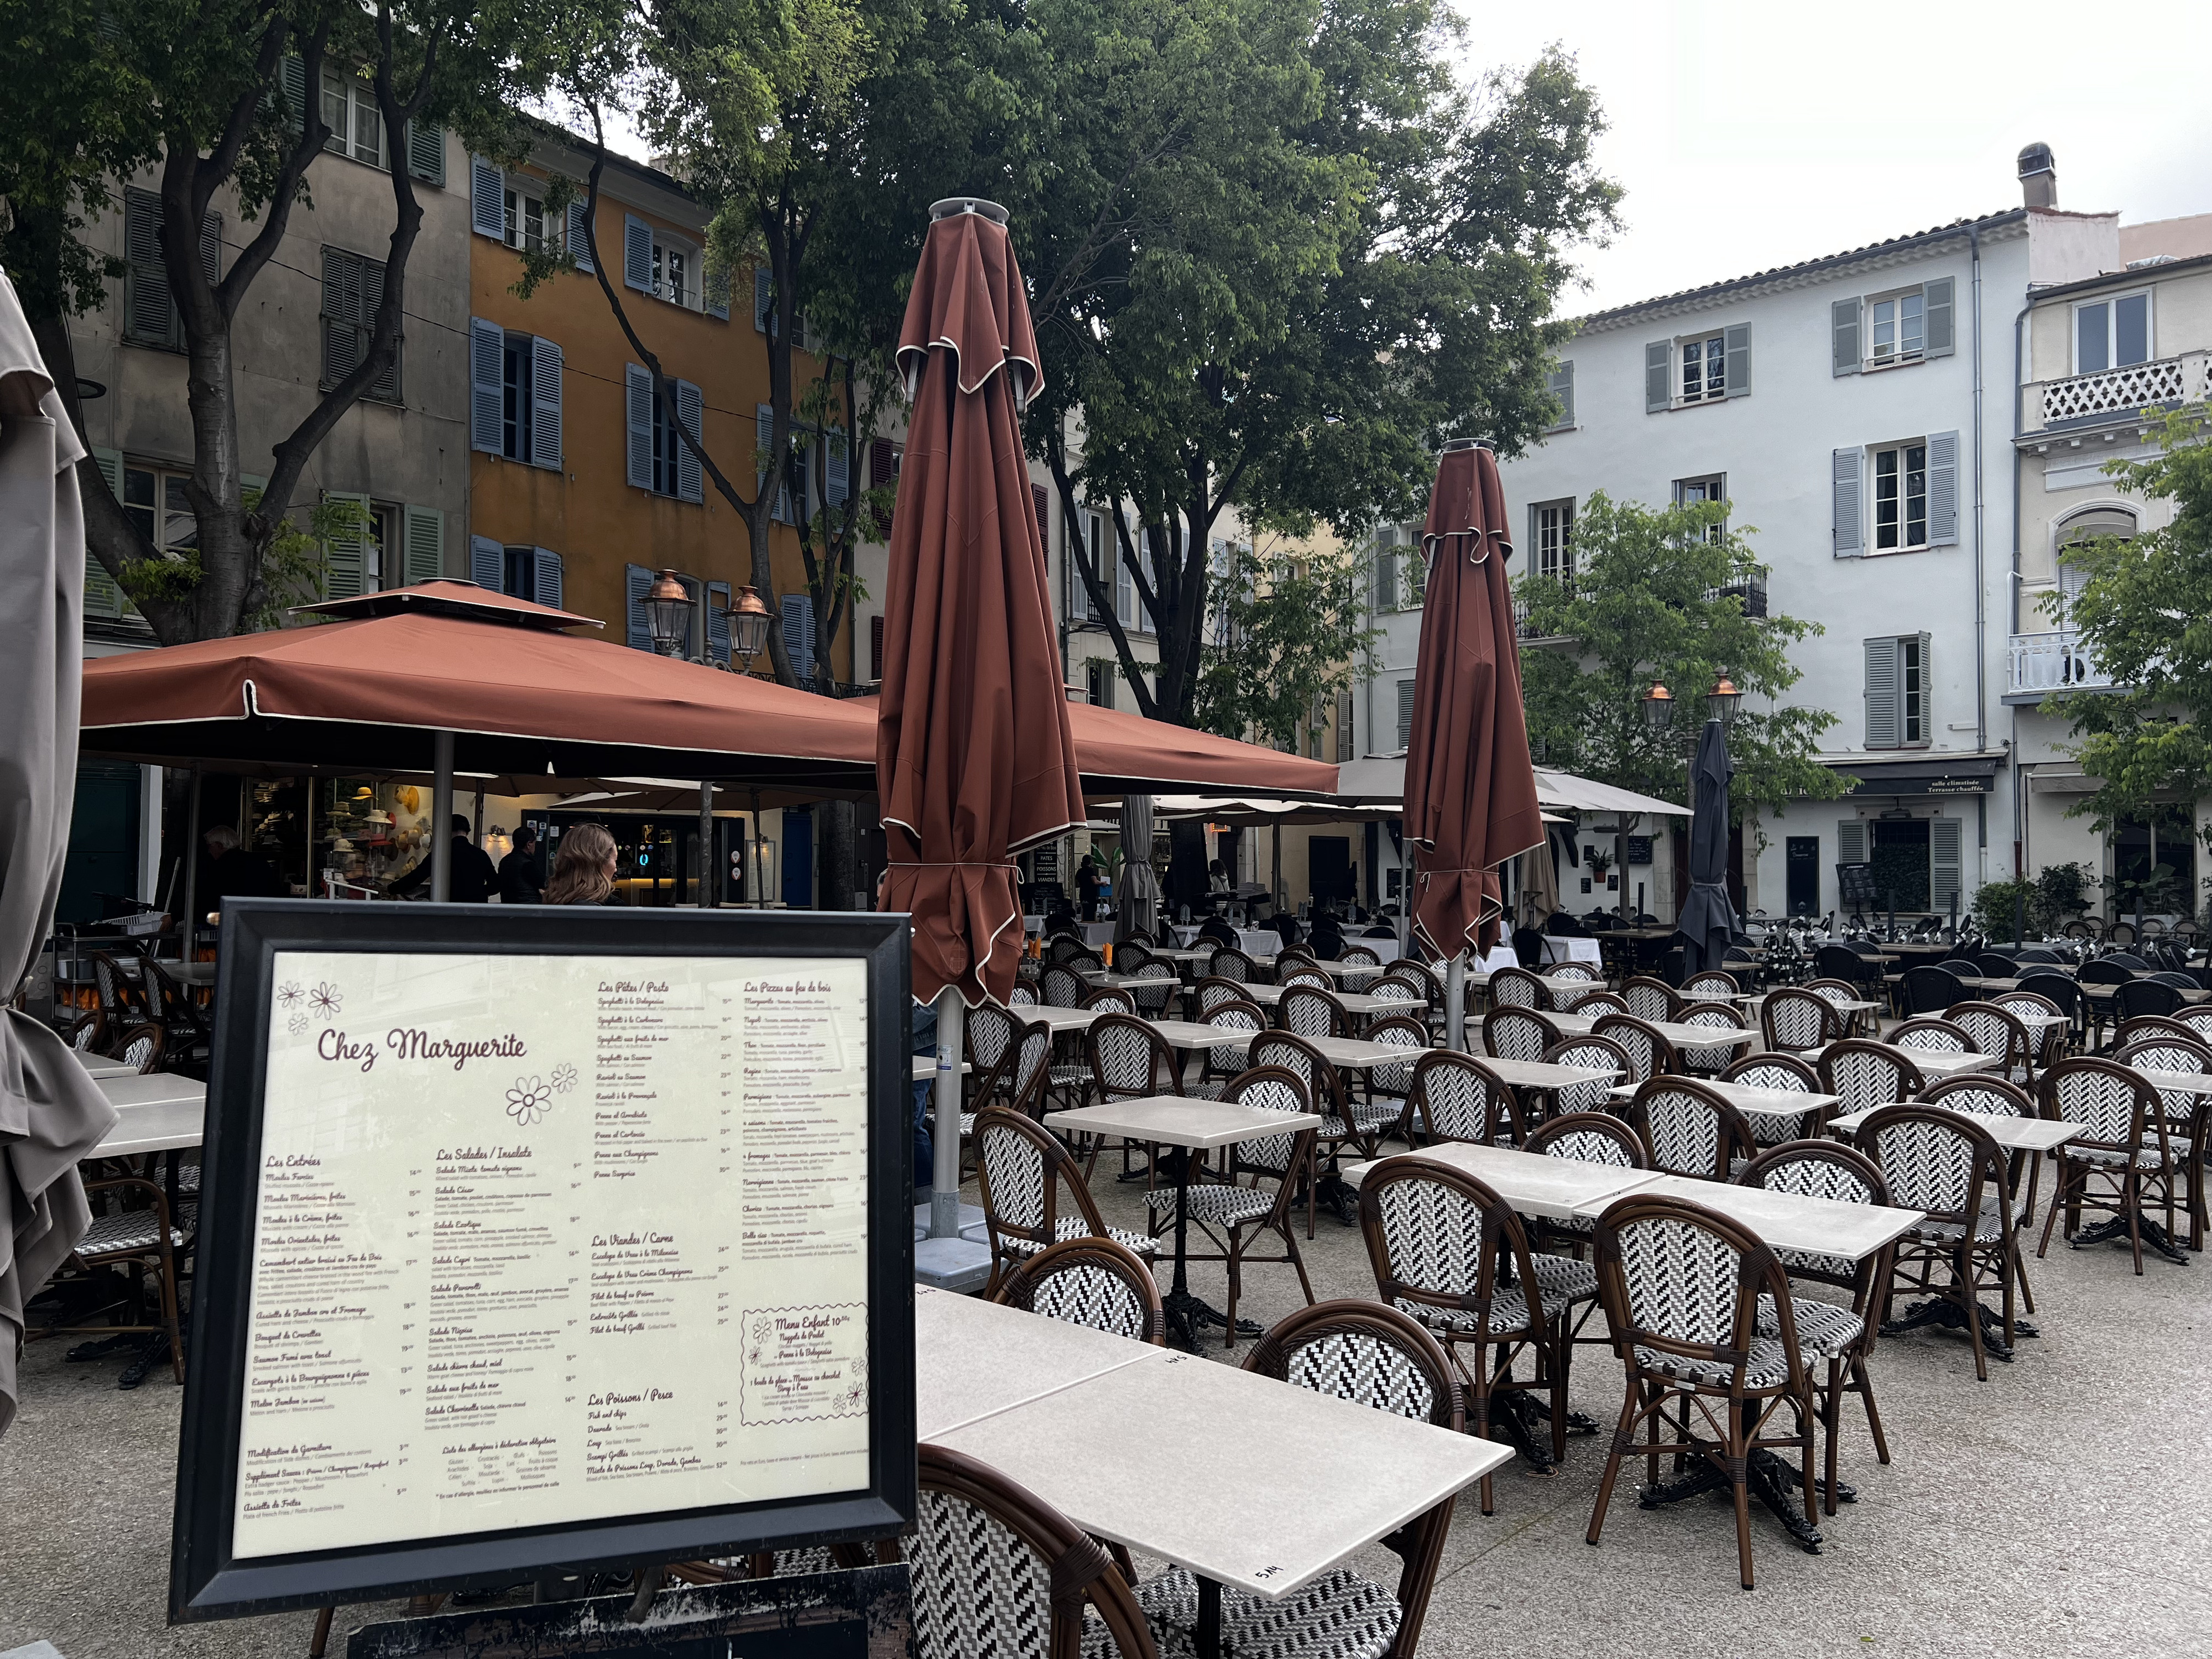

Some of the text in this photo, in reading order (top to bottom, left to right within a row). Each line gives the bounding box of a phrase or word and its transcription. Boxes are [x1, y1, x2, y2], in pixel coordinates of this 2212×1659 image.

[598, 982, 613, 992] Les
[616, 982, 637, 993] Pâtes
[646, 982, 669, 992] Pasta
[744, 982, 758, 992] Les
[760, 982, 783, 993] Pizzas
[796, 981, 806, 995] feu
[808, 981, 816, 992] de
[817, 981, 831, 992] bois
[318, 1028, 528, 1072] Chez Marguerite
[436, 1149, 452, 1161] Les
[455, 1147, 487, 1160] Salades
[497, 1145, 532, 1159] Insalate
[624, 1150, 659, 1160] Champignons
[265, 1154, 321, 1168] Les Entrées
[591, 1235, 607, 1247] Les
[610, 1232, 640, 1245] Viandes
[650, 1232, 674, 1243] Carne
[775, 1318, 800, 1331] Menu
[802, 1314, 830, 1331] Enfant
[587, 1394, 604, 1406] Les
[606, 1391, 641, 1405] Poissons
[651, 1388, 673, 1401] Pesce
[248, 1447, 289, 1459] Modification
[244, 1503, 270, 1512] Assiette
[281, 1499, 301, 1509] Frites
